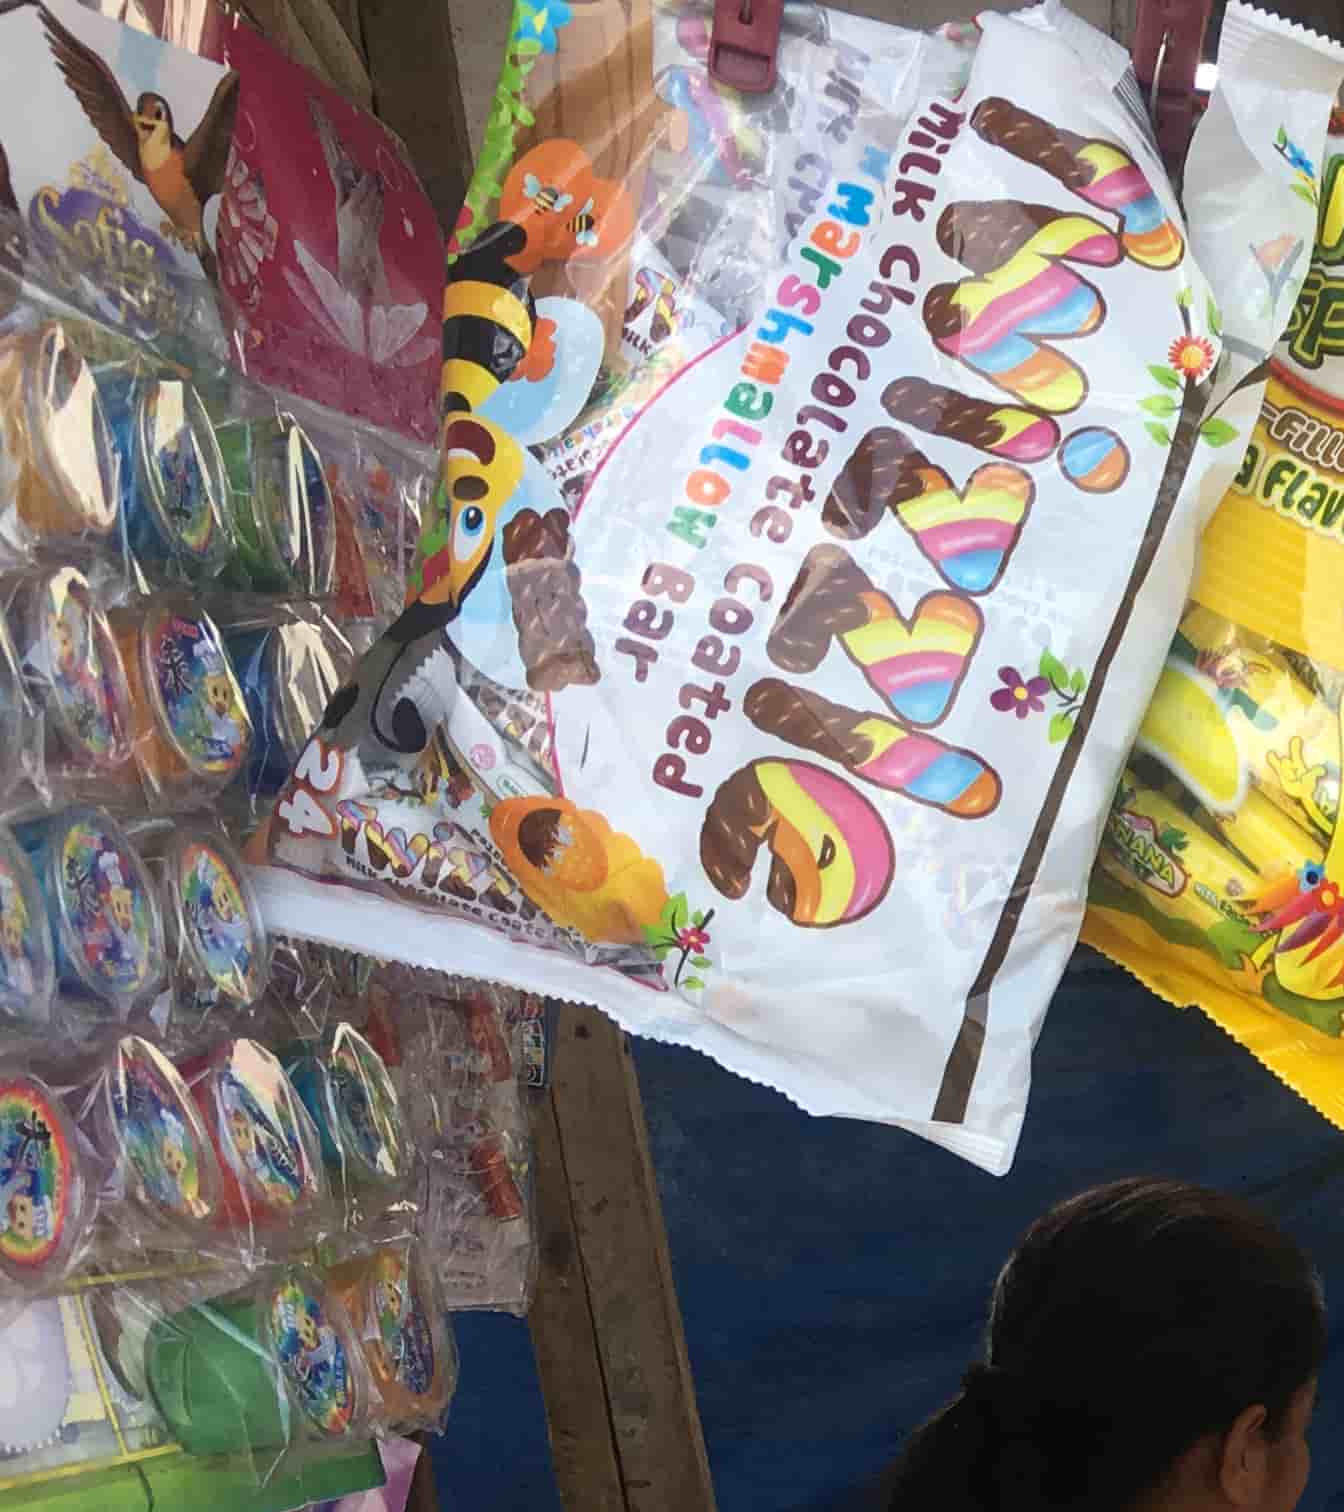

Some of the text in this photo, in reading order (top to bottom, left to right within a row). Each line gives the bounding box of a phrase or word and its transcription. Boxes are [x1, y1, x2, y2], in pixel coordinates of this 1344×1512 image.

[770, 245, 920, 544] Chocolate
[619, 562, 697, 683] Bar
[653, 562, 772, 798] Coated
